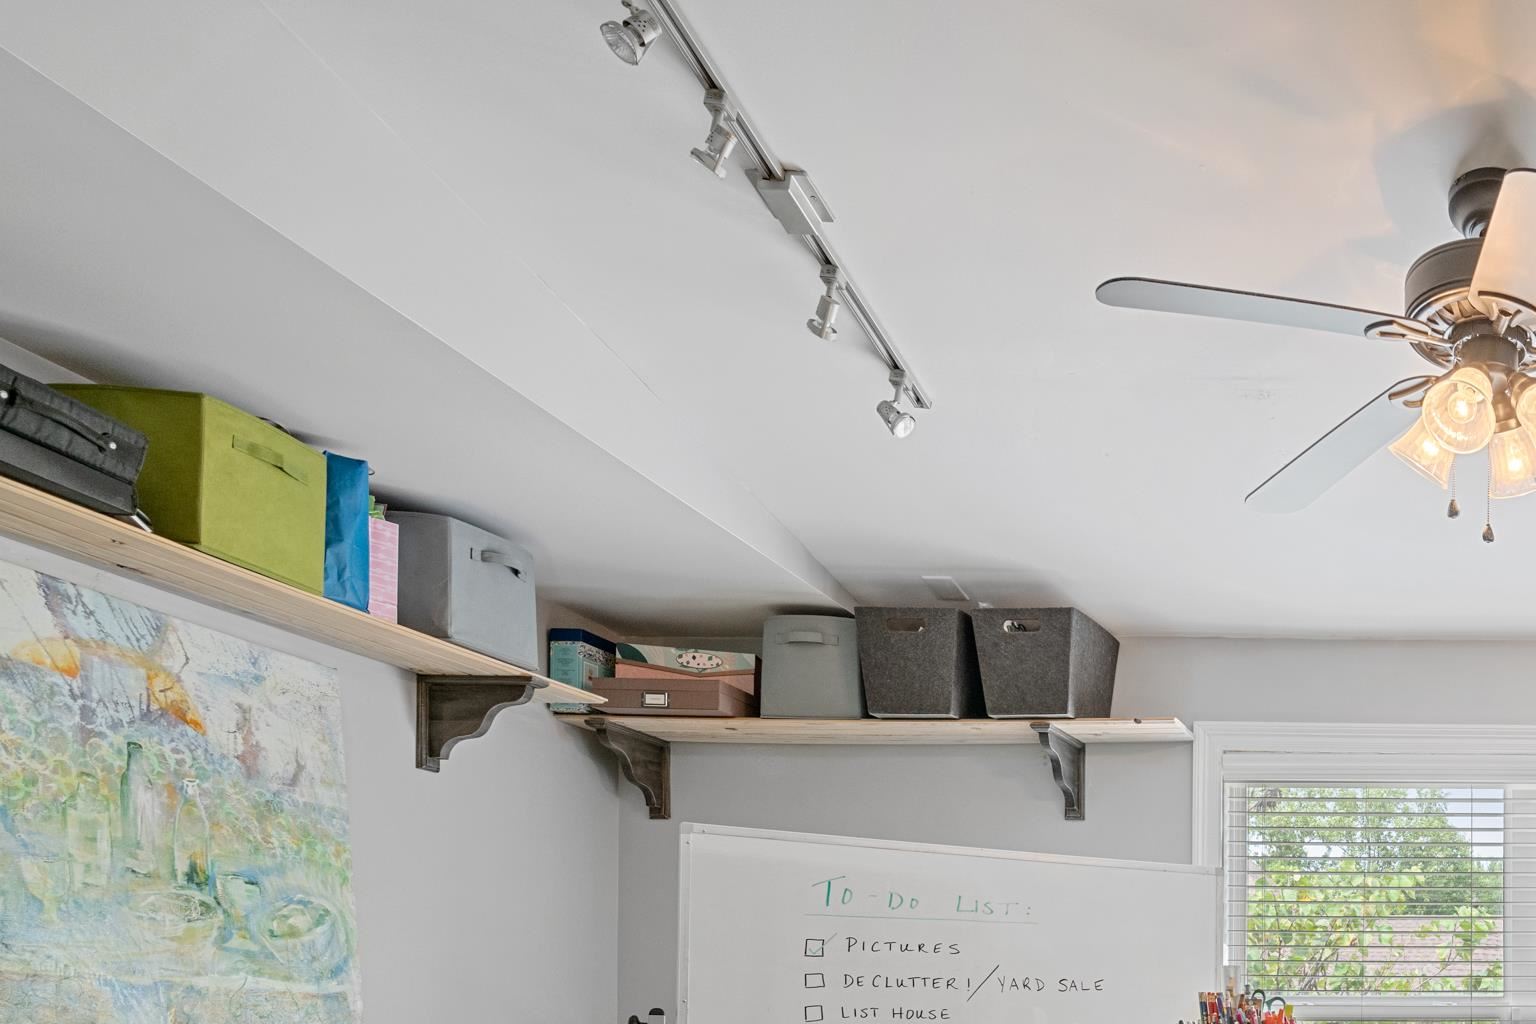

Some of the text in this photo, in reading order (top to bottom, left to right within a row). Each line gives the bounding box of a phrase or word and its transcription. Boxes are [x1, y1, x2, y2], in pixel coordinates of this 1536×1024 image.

[956, 895, 1033, 916] LIST:
[845, 935, 961, 956] PICTURES
[1056, 978, 1105, 993] SALE
[840, 1005, 952, 1022] LIST HOUSE
